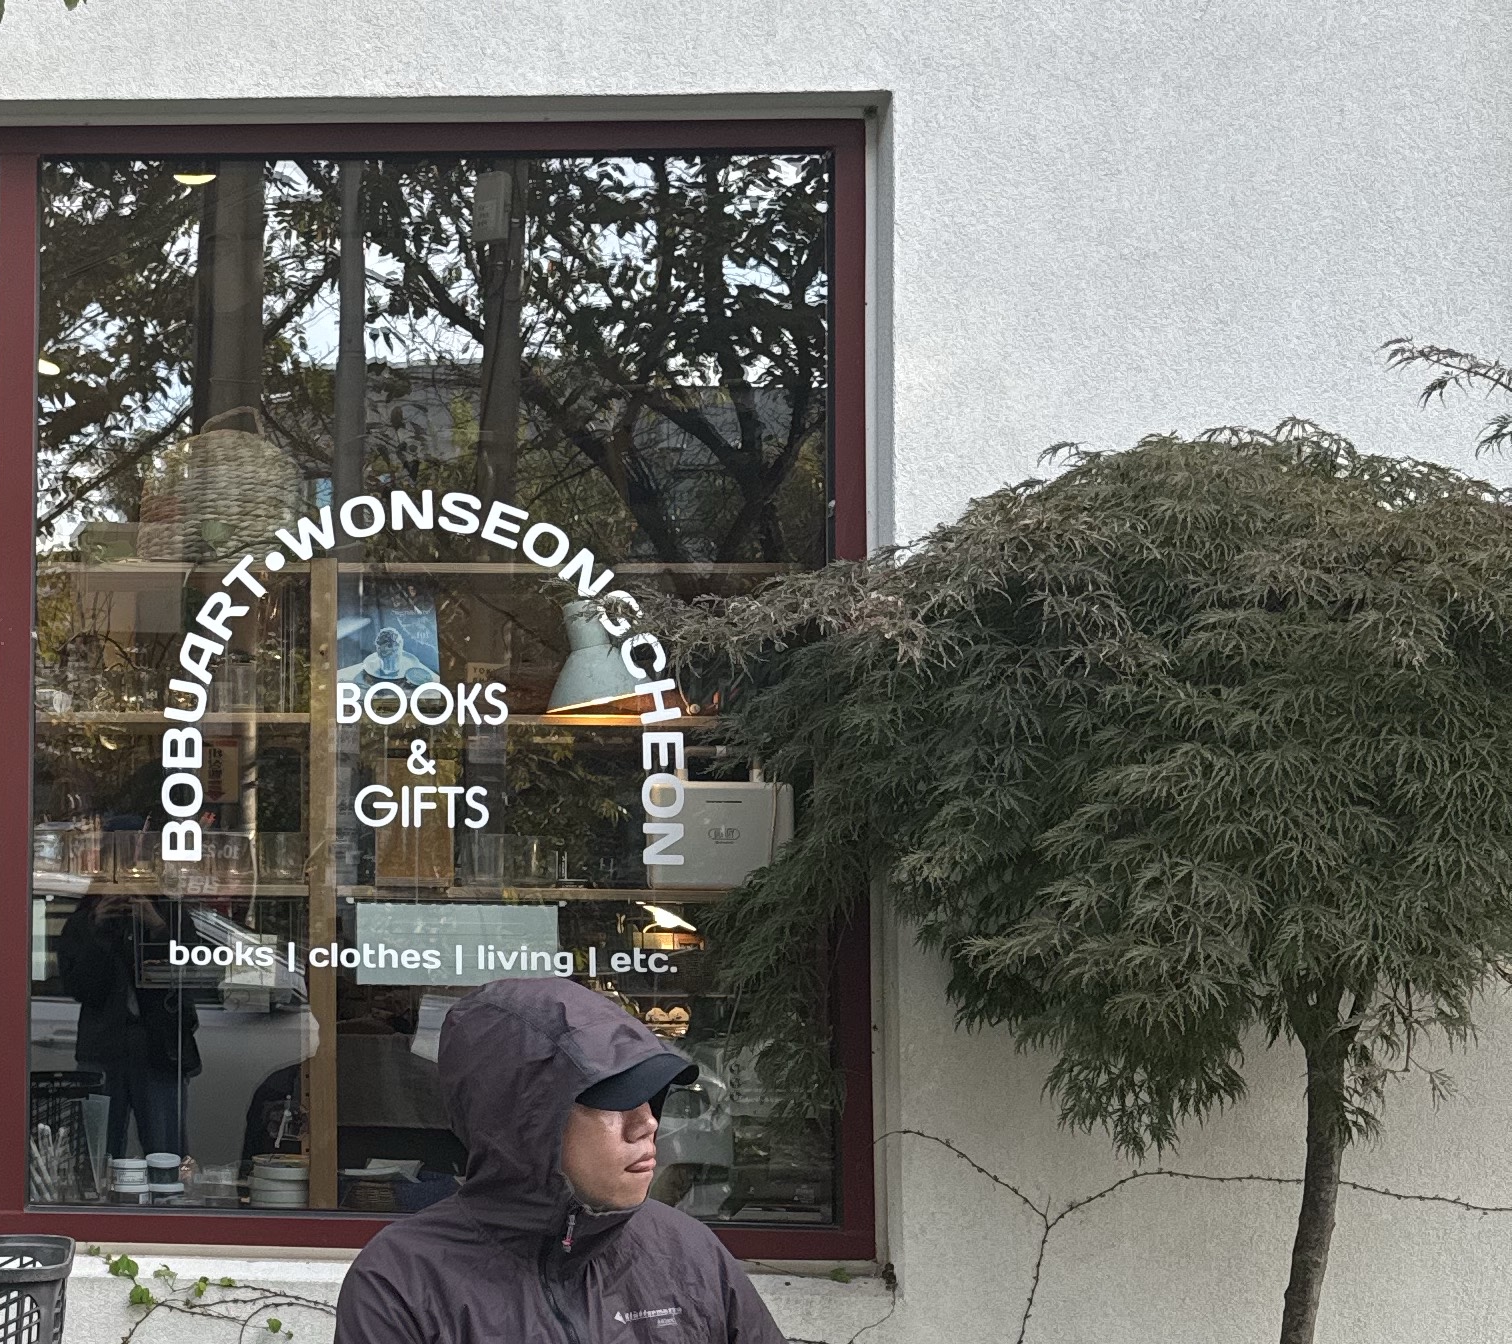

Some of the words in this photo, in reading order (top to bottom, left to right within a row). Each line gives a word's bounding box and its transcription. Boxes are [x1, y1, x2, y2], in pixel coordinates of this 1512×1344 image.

[161, 553, 269, 862] BOBUART
[275, 489, 685, 866] WONSEONGCHEON
[336, 681, 509, 726] BOOKS
[406, 739, 437, 775] &
[354, 784, 489, 829] GIFTS
[169, 940, 275, 967] books
[308, 942, 442, 970] clothes
[477, 944, 574, 977] living
[610, 947, 678, 973] etc.
